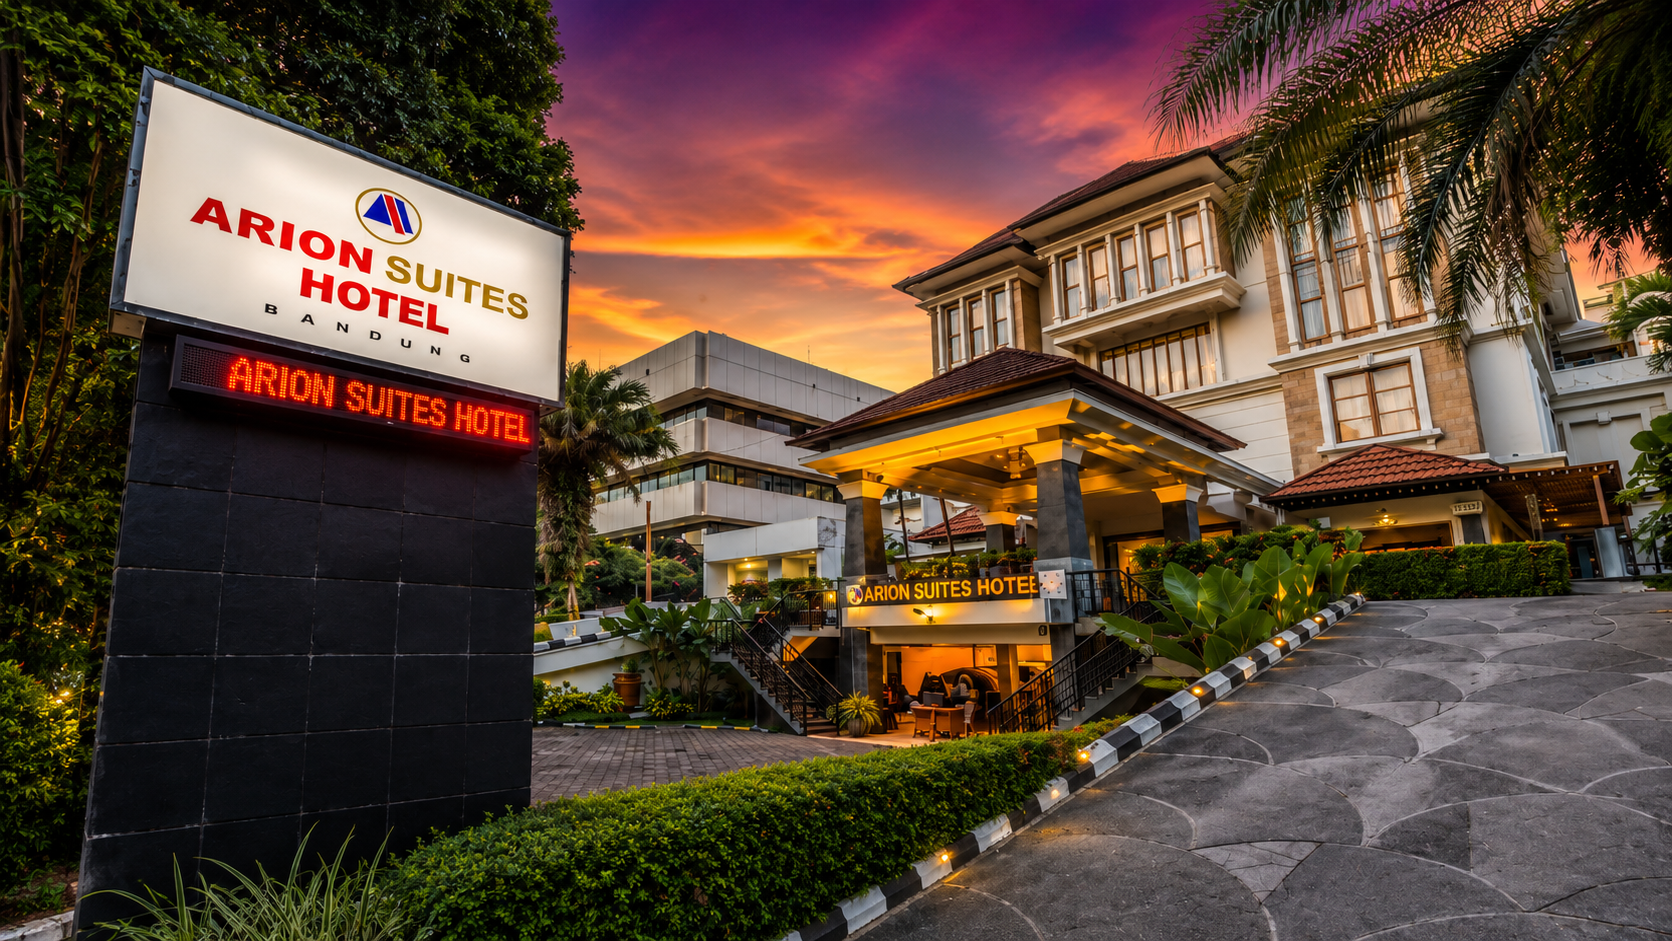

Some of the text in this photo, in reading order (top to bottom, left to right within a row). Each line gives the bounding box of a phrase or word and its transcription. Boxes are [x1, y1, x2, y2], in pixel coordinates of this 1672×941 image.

[190, 197, 529, 320] ARION SUITES
[299, 267, 449, 335] HOTEL
[228, 357, 531, 444] ARION SUITES HOTEL
[864, 583, 910, 602] ARION
[913, 579, 972, 600] SUITES
